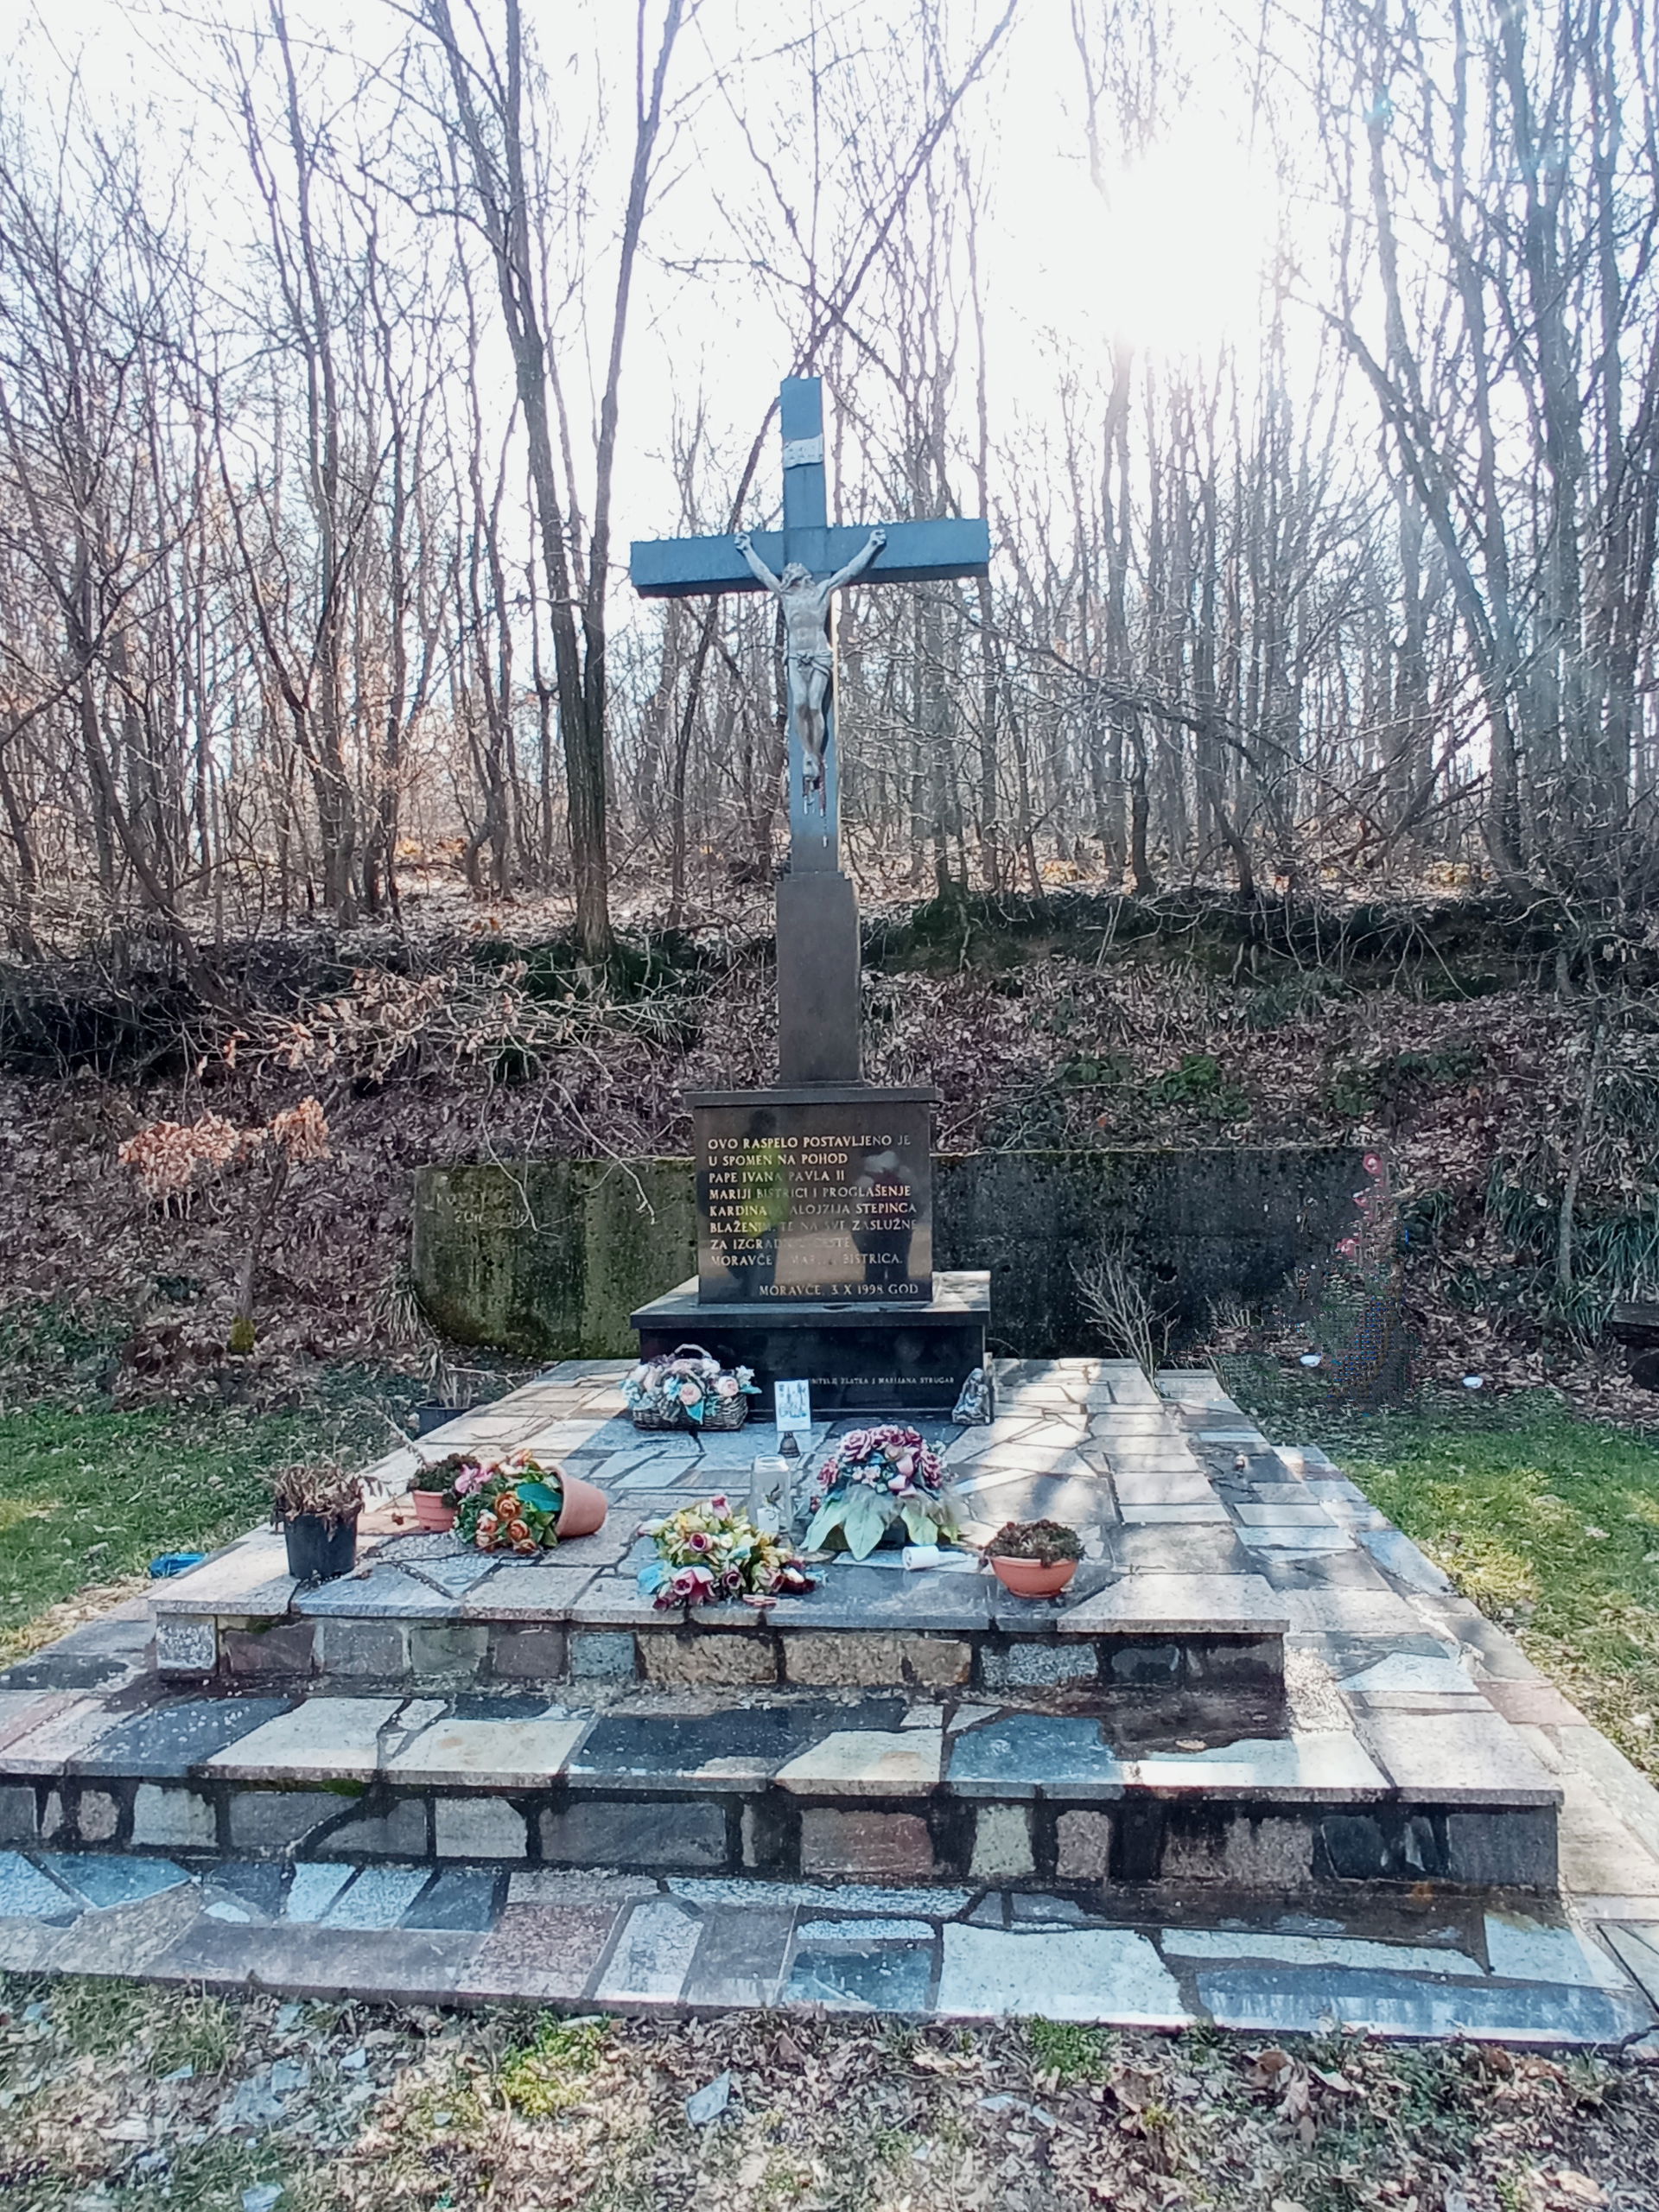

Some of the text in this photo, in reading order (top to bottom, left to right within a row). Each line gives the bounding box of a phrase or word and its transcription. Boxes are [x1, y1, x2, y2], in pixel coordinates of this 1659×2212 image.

[708, 1135, 912, 1149] OVO RASPELO POSTAVLJENO JE
[709, 1153, 849, 1166] U SPOMEN NA POHOD
[709, 1170, 845, 1183] PAPE IVANA PAVLA II
[709, 1184, 912, 1200] MARIJI BISTRICI I PROGLAŠENJE
[789, 1204, 850, 1216] ALOJZIJA
[855, 1202, 917, 1215] STEPINCA
[779, 1222, 794, 1232] TE
[800, 1221, 817, 1231] NA
[824, 1220, 845, 1231] SVE
[852, 1217, 917, 1231] ZASLUŽNE
[710, 1238, 728, 1249] ZA
[711, 1253, 773, 1266] MORAVČE
[842, 1252, 903, 1265] BISTRICA.
